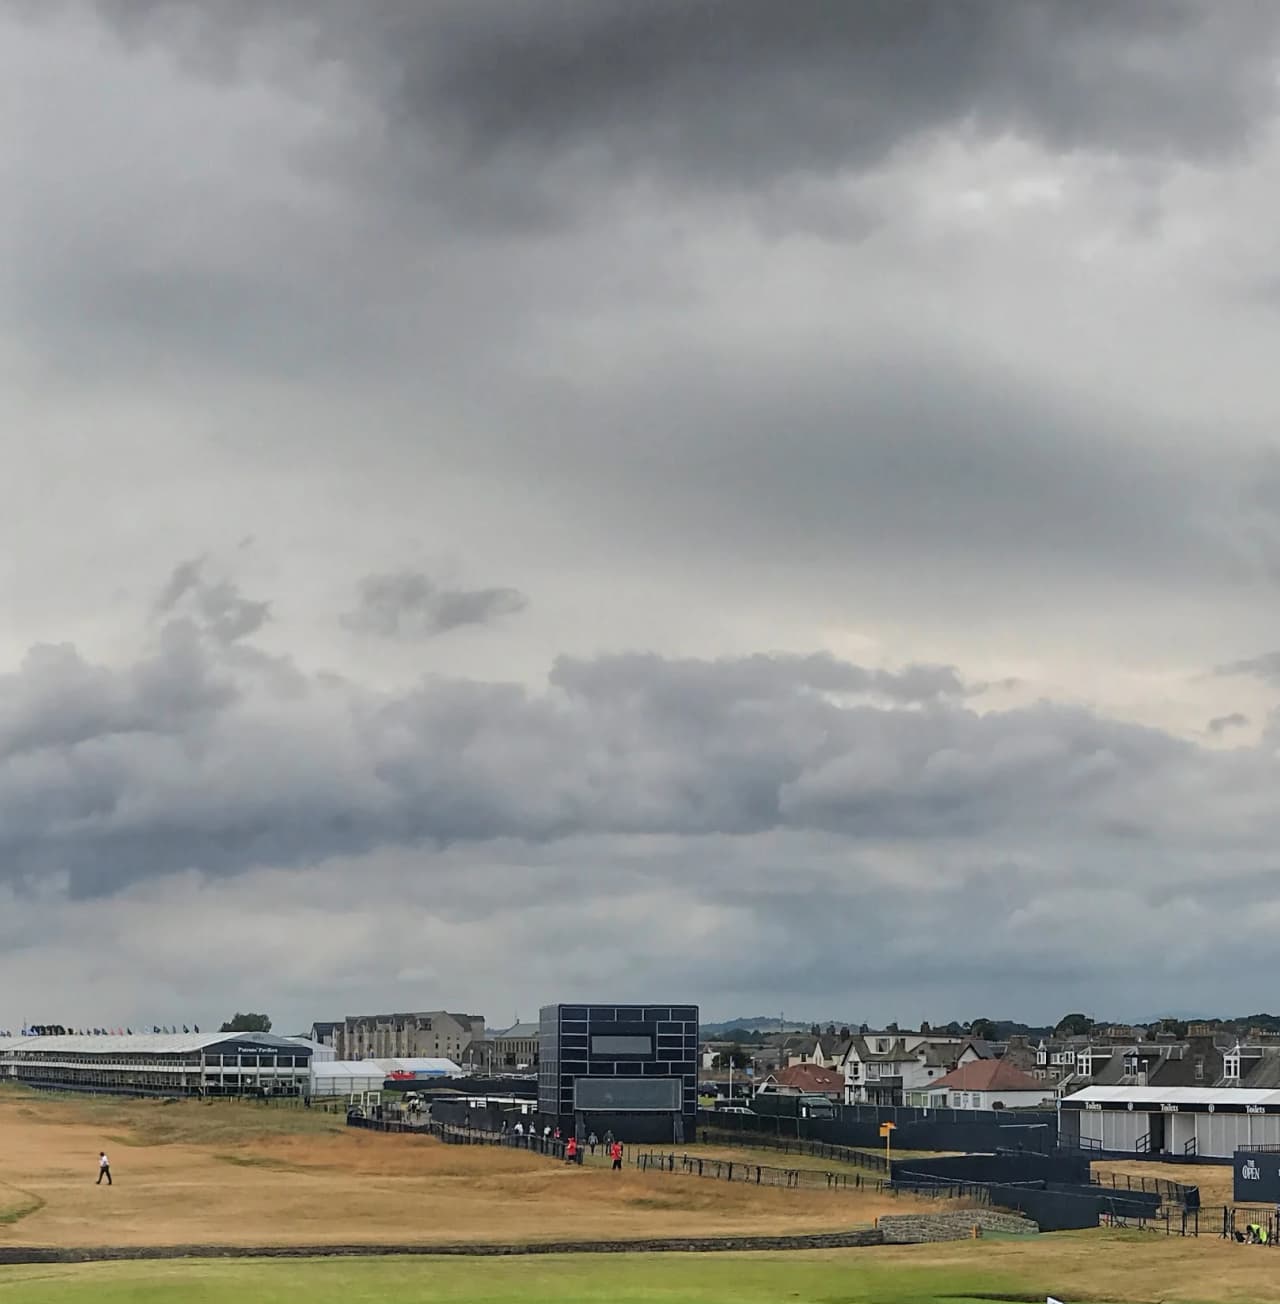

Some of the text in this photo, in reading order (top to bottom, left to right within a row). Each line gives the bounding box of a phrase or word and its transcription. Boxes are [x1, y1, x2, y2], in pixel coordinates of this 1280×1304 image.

[1085, 1102, 1102, 1110] Toilets
[1160, 1104, 1178, 1112] Toilets
[1245, 1105, 1266, 1113] Toilets
[1242, 1166, 1260, 1180] OPEN
